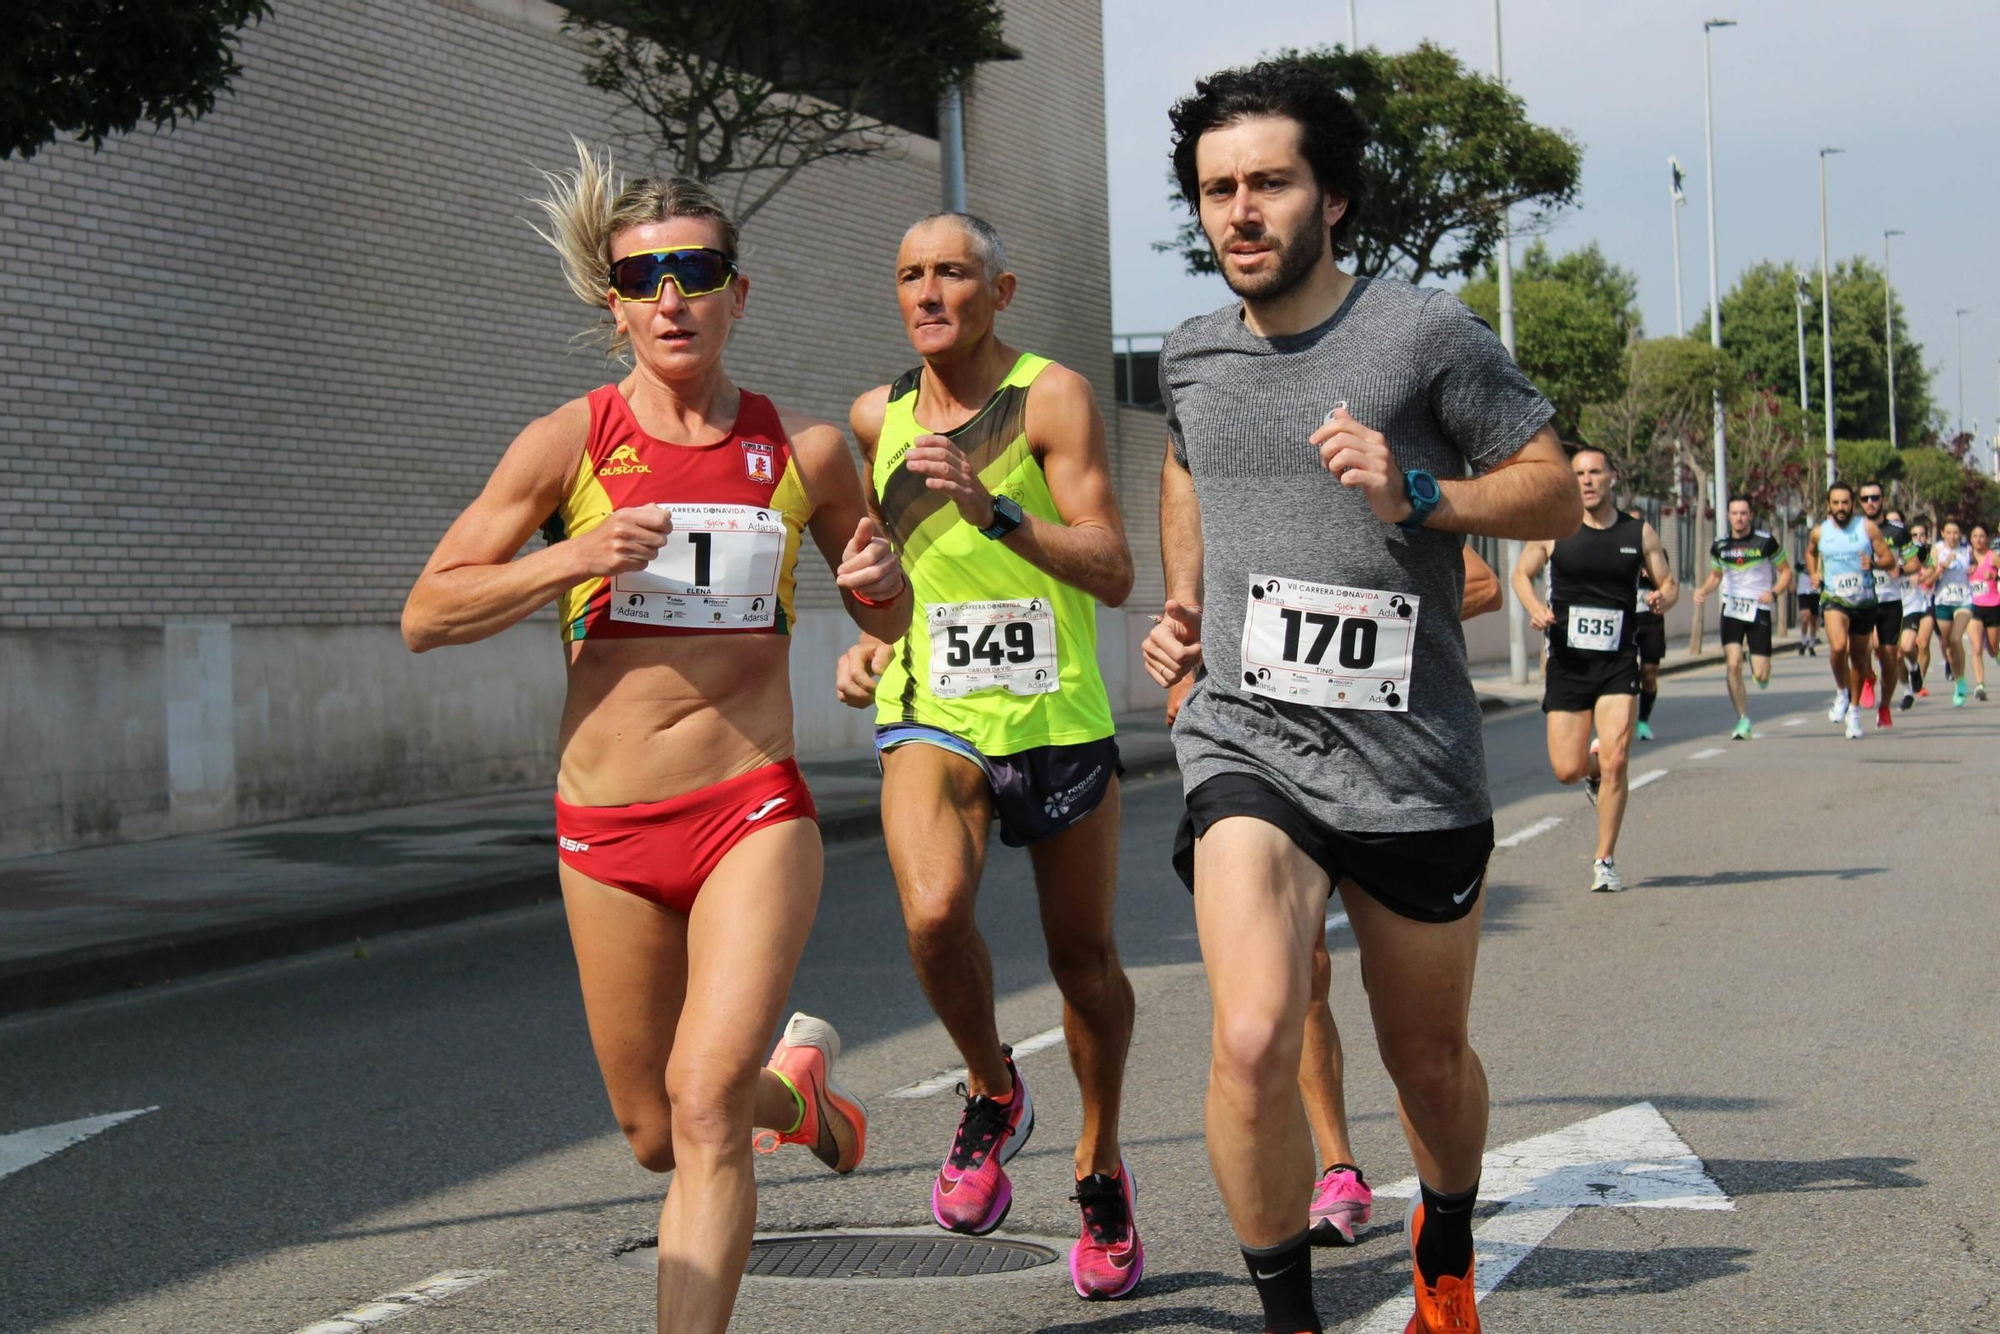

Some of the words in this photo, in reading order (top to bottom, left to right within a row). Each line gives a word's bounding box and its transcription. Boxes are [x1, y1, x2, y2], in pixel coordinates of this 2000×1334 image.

[600, 464, 652, 476] austral
[748, 522, 779, 532] Adarsa
[688, 532, 712, 587] 1
[1287, 582, 1298, 591] VII
[1299, 585, 1335, 596] CARRERA
[1336, 591, 1379, 600] DONAVIDA
[1262, 594, 1285, 605] darsa
[617, 606, 649, 619] Adarsa
[742, 613, 769, 622] Adarsa
[1378, 608, 1401, 617] Adar
[1577, 618, 1614, 637] 635
[946, 621, 1035, 667] 549
[1281, 608, 1378, 669] 170
[1315, 667, 1334, 675] TINO
[1369, 694, 1387, 704] Ada
[1067, 764, 1102, 796] reguera
[559, 835, 590, 853] ESP
